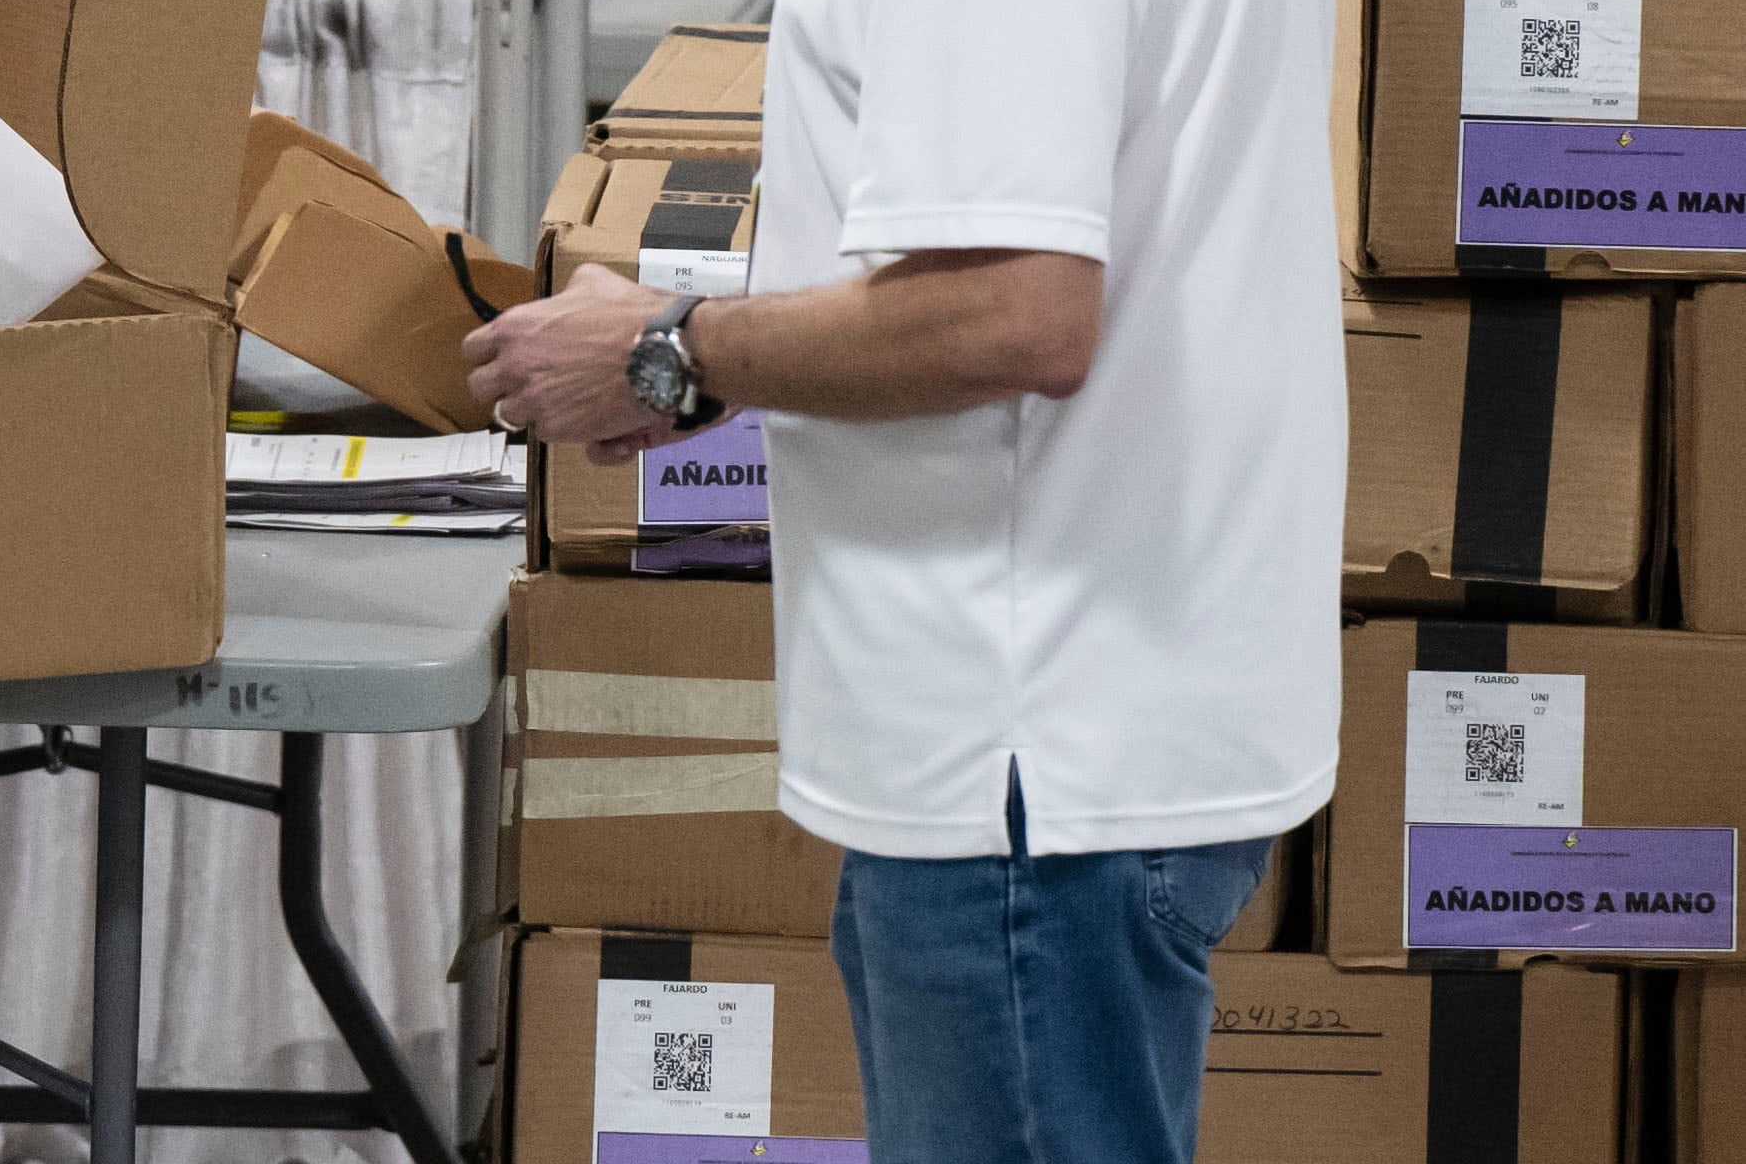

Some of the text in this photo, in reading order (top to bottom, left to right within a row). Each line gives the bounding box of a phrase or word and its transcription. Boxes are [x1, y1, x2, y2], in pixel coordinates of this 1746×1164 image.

[1478, 182, 1746, 214] AÑADIDOS A MAN
[675, 268, 693, 276] PRE
[1474, 675, 1519, 684] FAJARDO
[1446, 690, 1549, 702] PRE UNI
[1425, 886, 1716, 914] AÑADIDOS A MANO
[663, 984, 708, 994] FAJARDO
[634, 999, 737, 1011] PRE UNI
